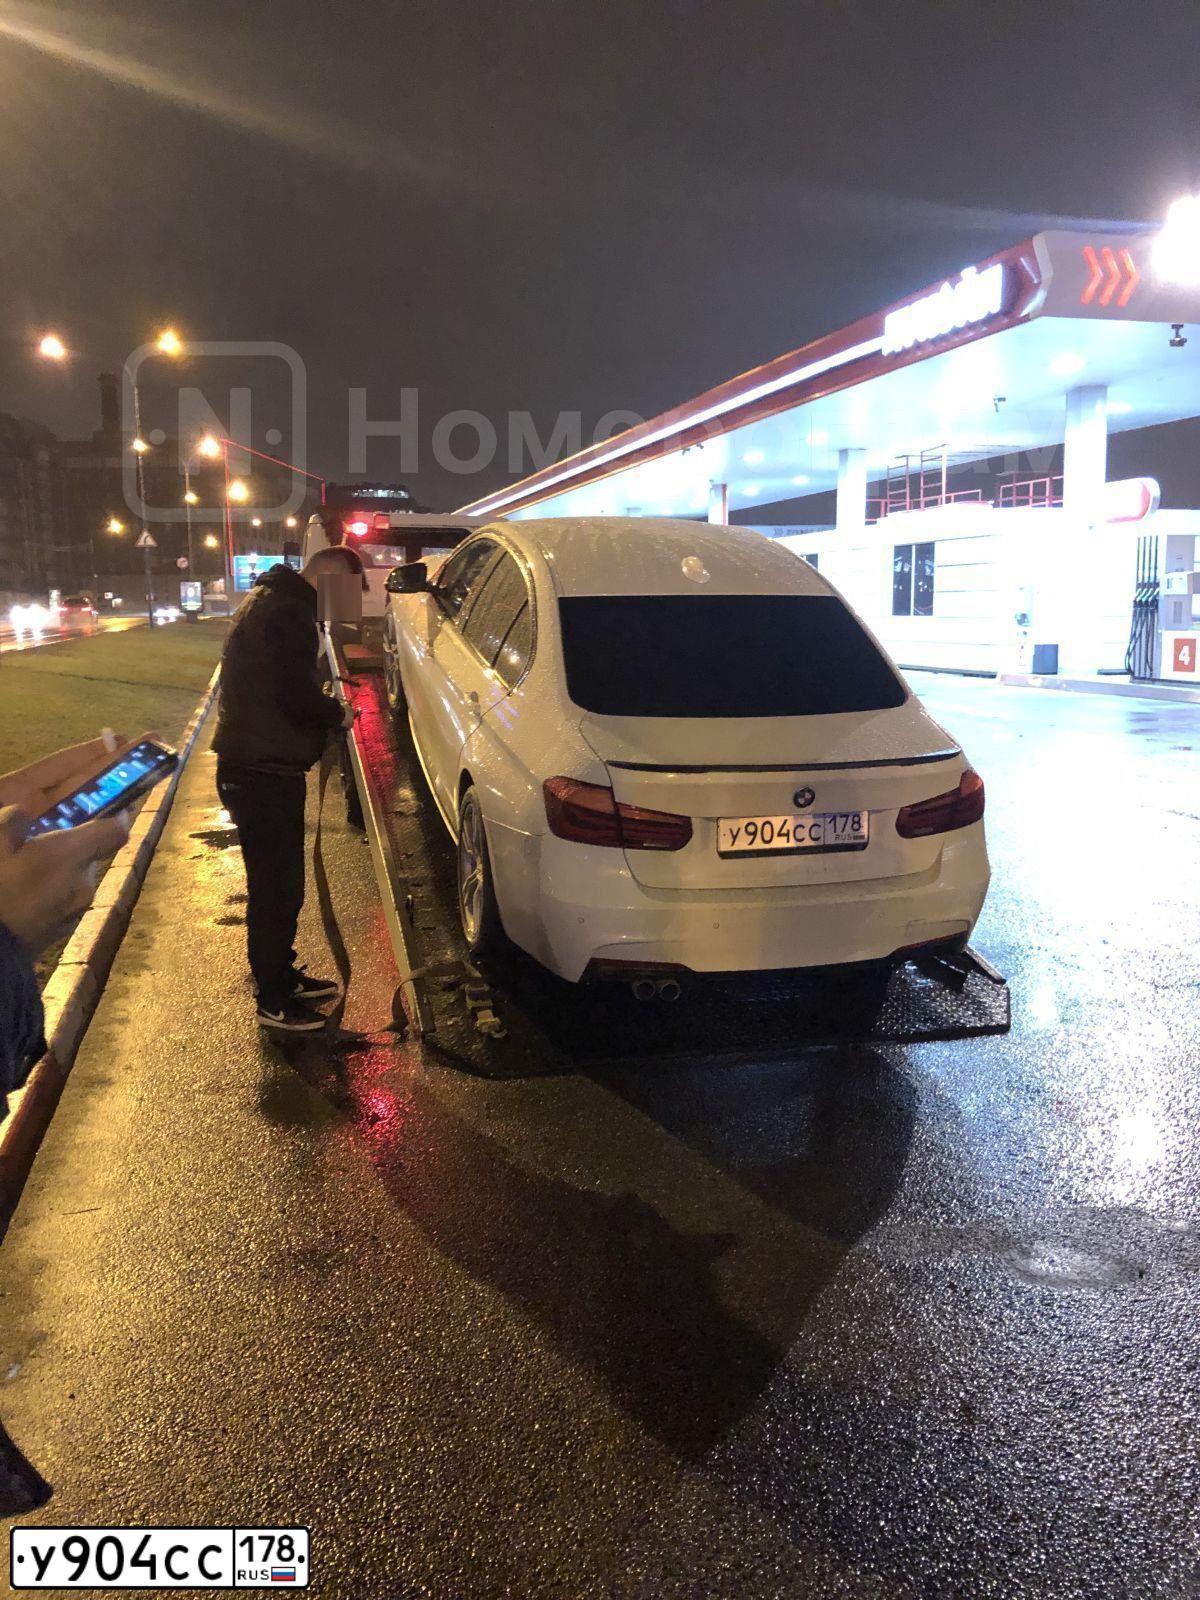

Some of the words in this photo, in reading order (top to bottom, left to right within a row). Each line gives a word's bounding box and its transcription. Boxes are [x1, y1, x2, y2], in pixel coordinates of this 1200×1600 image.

[1178, 645, 1190, 666] 4
[729, 819, 821, 847] У904СС
[828, 814, 862, 833] 178
[834, 833, 852, 841] RUS
